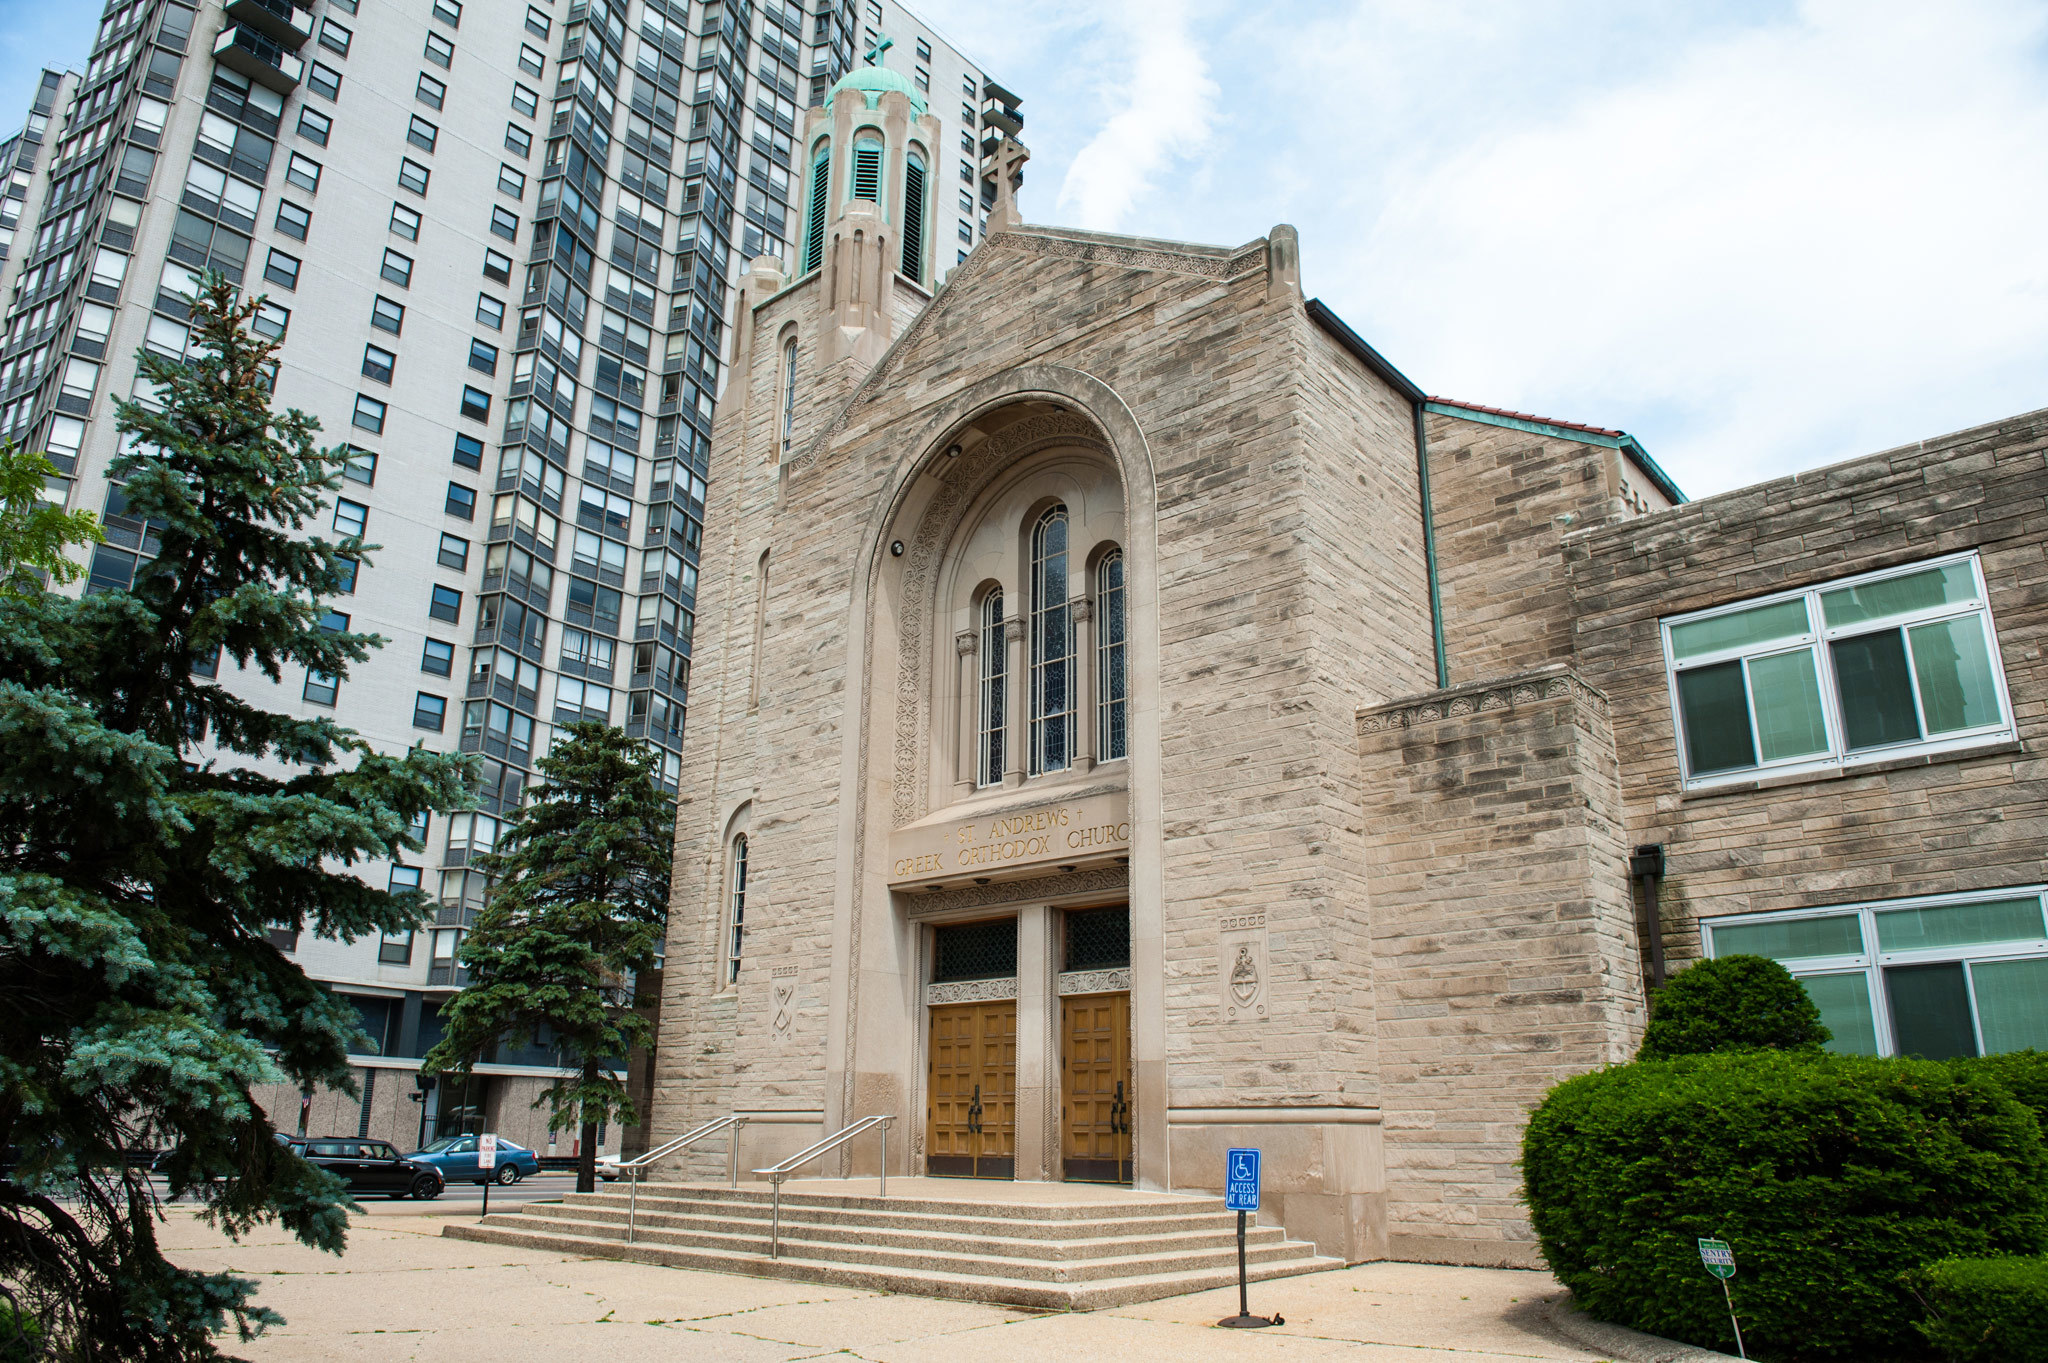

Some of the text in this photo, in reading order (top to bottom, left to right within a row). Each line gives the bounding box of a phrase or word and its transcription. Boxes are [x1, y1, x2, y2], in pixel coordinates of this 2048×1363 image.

[957, 824, 978, 845] ST.
[894, 853, 944, 877] GREEK
[958, 835, 1051, 867] ORTHODOX
[485, 1137, 493, 1145] NO
[481, 1145, 496, 1153] PARKING
[1230, 1182, 1256, 1194] ACCESS
[1228, 1194, 1257, 1206] AT REAR
[1700, 1248, 1731, 1258] SENTRY
[1702, 1257, 1734, 1265] SECURITY
